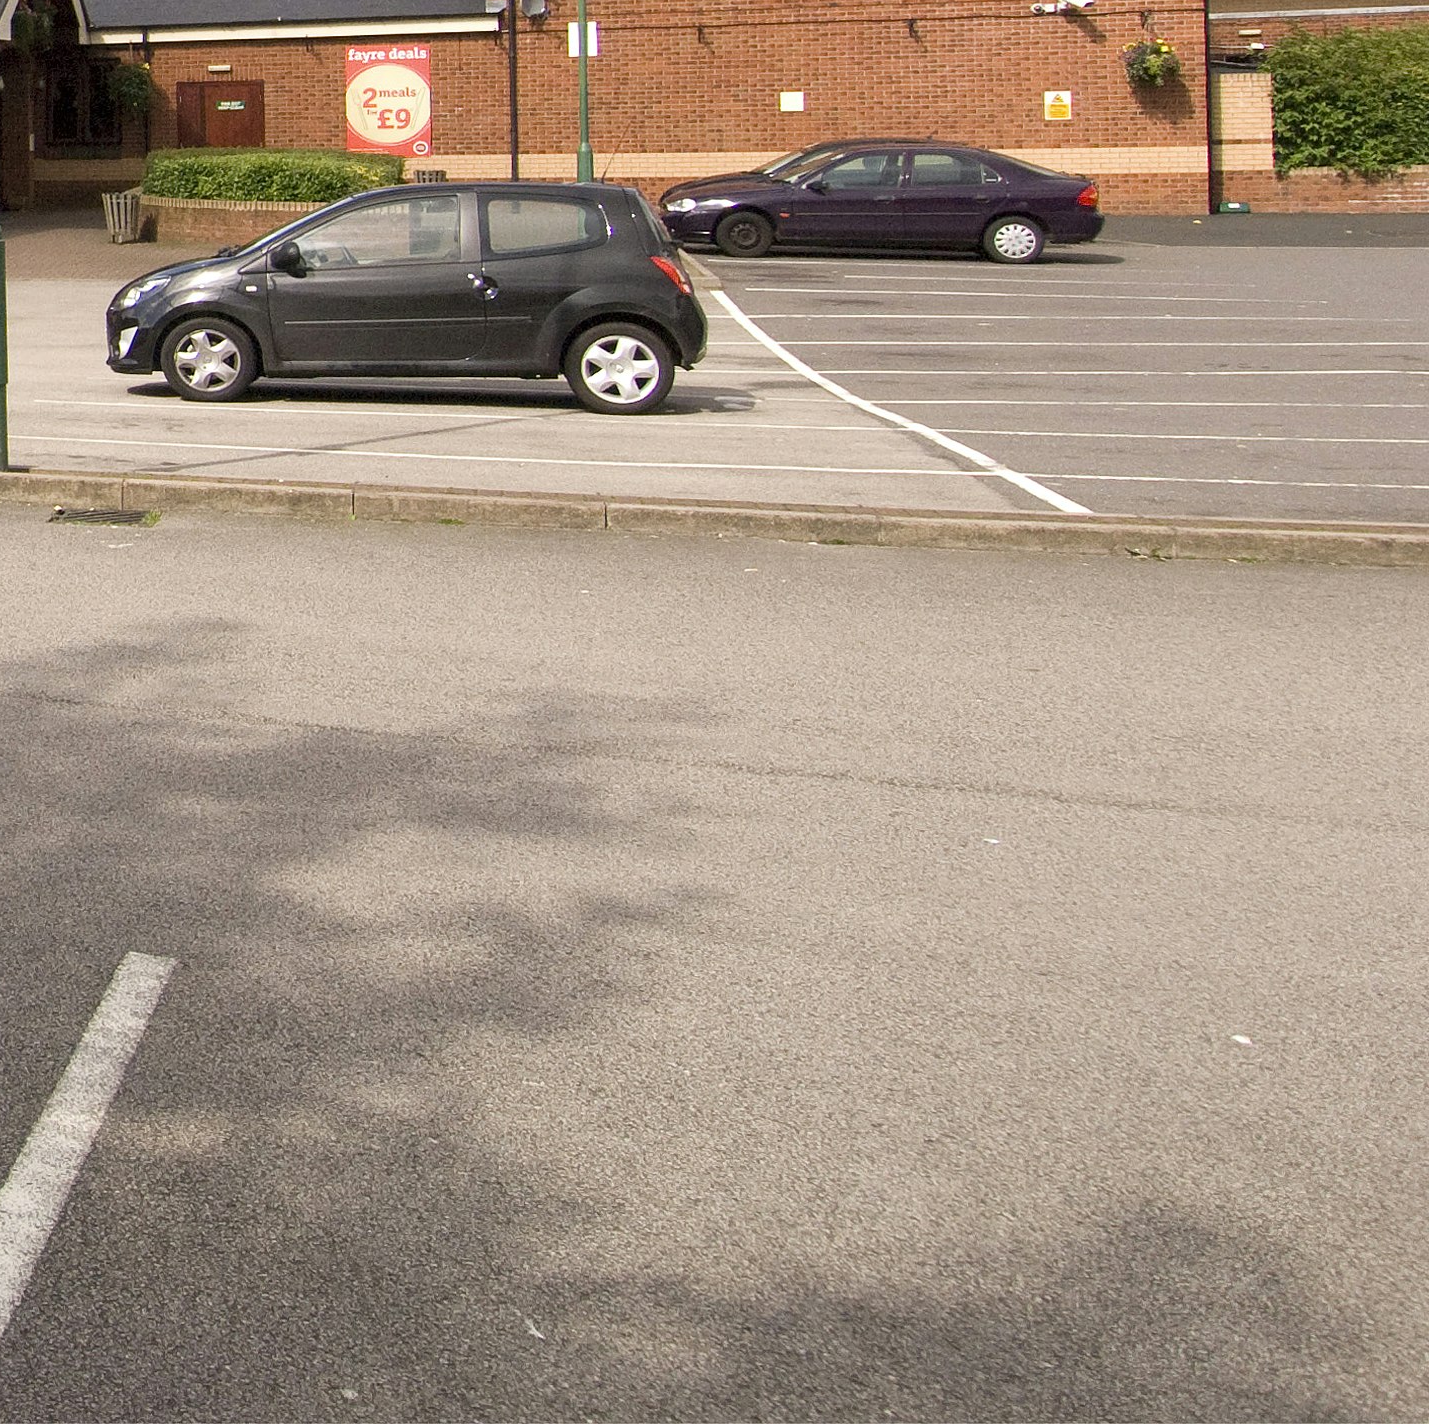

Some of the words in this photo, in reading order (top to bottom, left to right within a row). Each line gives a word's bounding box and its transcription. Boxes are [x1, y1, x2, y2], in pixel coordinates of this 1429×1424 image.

[348, 49, 386, 63] fayre
[388, 47, 427, 60] deals
[363, 87, 377, 108] 2
[379, 87, 417, 97] meals
[377, 108, 411, 129] £9
